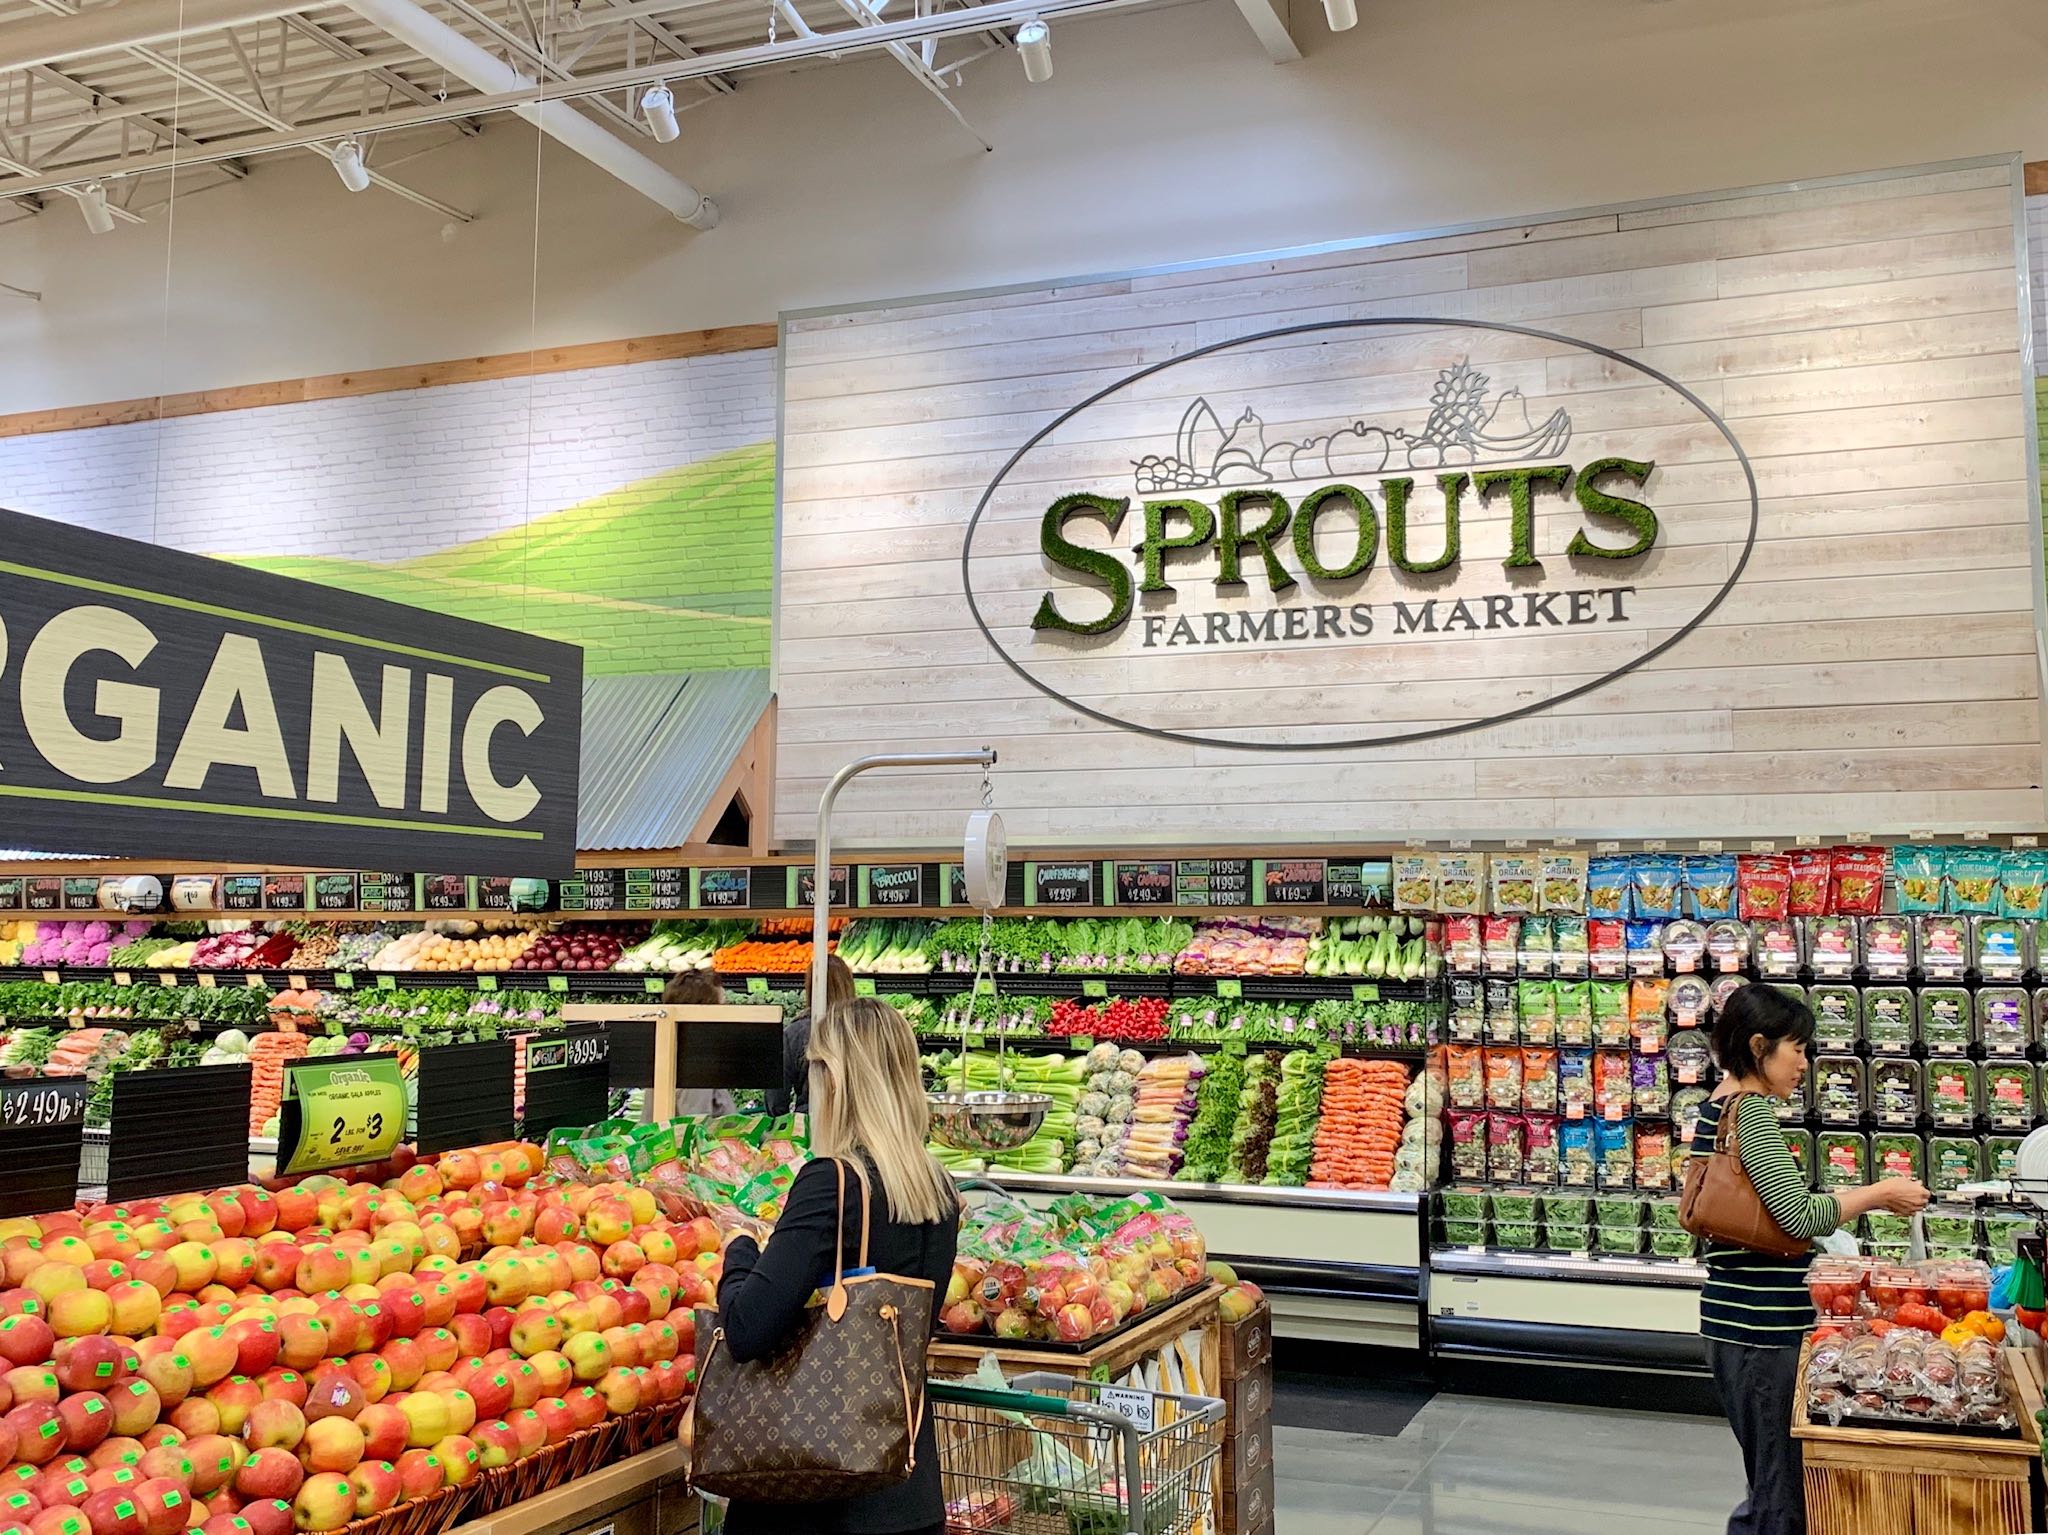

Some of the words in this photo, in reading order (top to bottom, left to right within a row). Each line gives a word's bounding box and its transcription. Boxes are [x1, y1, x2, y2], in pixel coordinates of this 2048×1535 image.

[1031, 457, 1660, 635] SPROUTS
[1142, 603, 1374, 647] FARMERS
[1393, 586, 1637, 634] MARKET
[877, 869, 917, 888] BROCCOLI
[1443, 868, 1476, 877] ORGANIC
[1498, 868, 1533, 877] ORGANIC
[329, 1069, 371, 1086] Organic
[330, 1116, 346, 1144] 2
[367, 1112, 383, 1140] $3
[1115, 1393, 1145, 1401] WARNING
